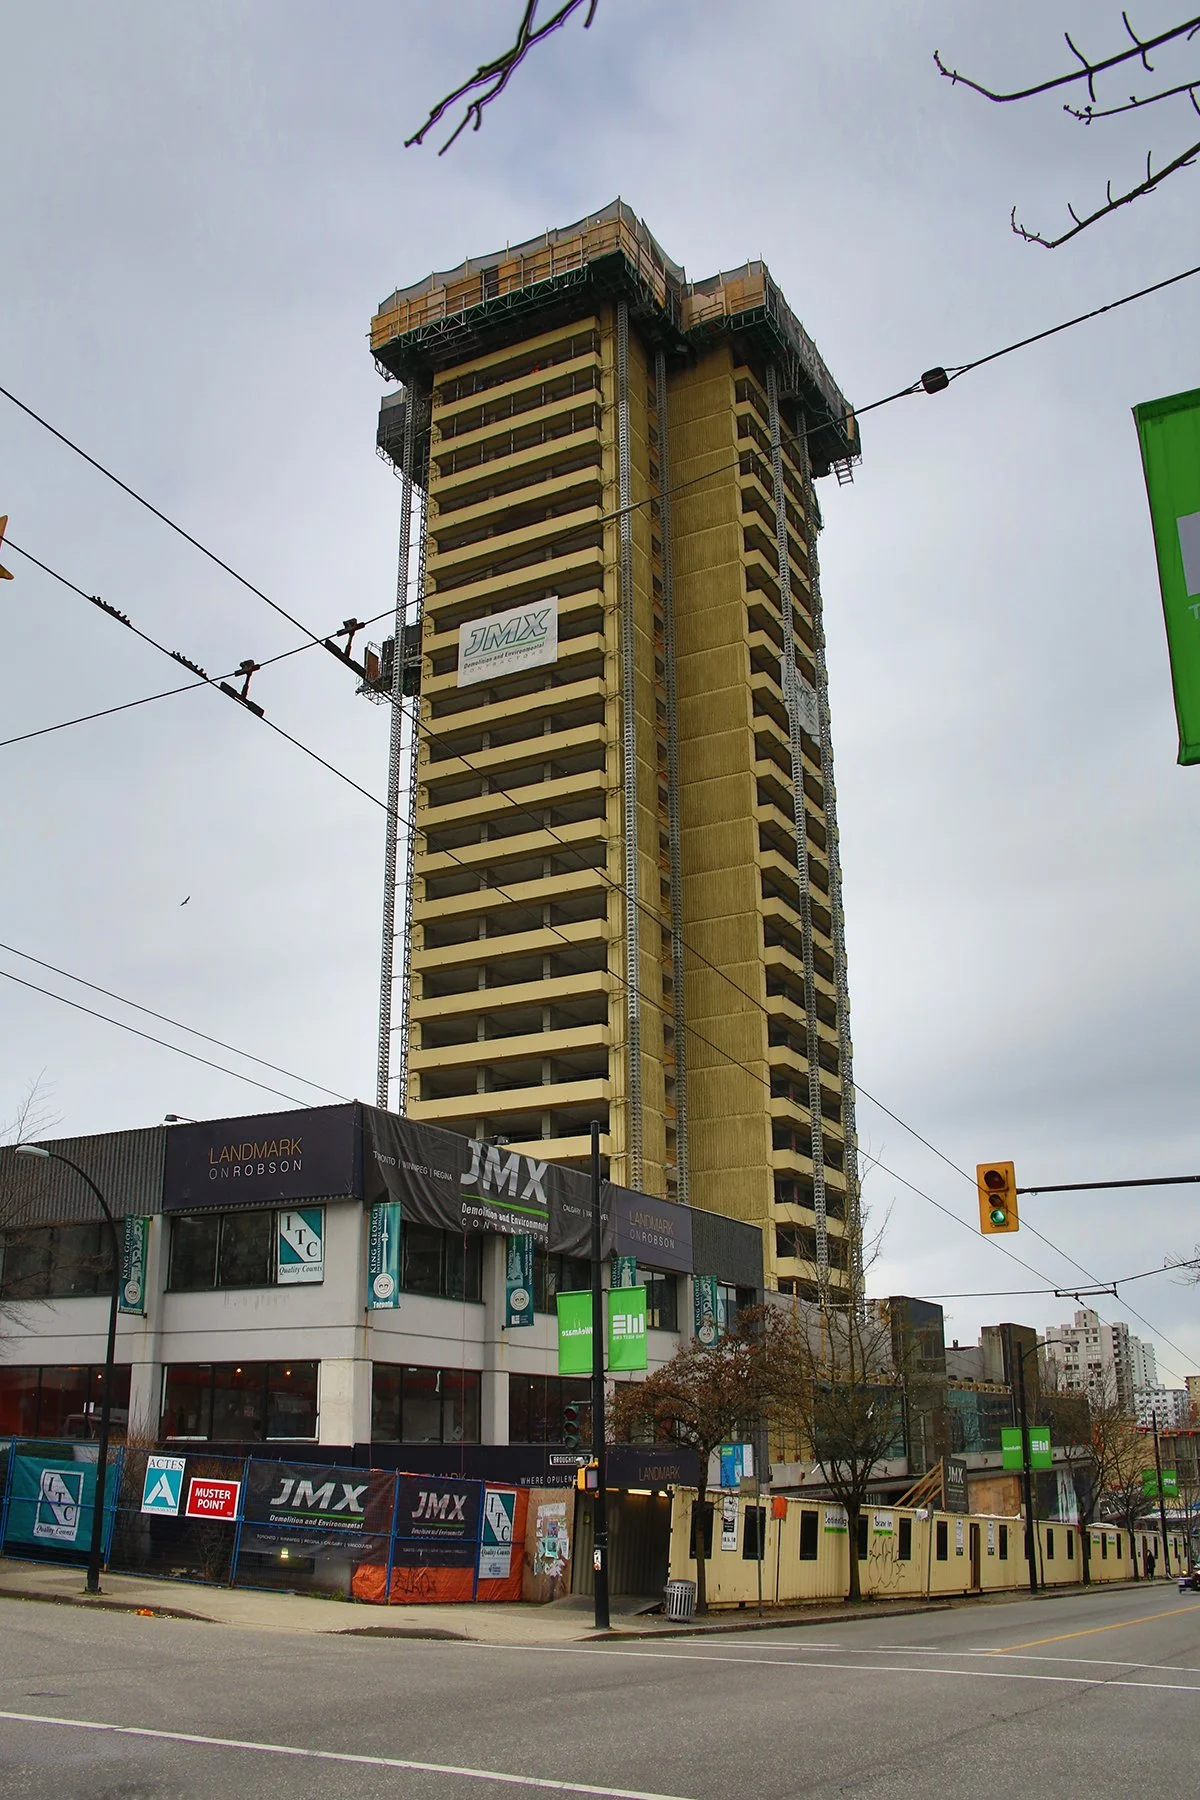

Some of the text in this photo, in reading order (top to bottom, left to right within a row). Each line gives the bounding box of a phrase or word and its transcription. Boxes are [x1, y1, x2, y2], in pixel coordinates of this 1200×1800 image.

[464, 608, 551, 657] JMX
[463, 642, 545, 670] Demolition and Environmental
[209, 1137, 302, 1164] LANDMARK
[460, 1140, 549, 1205] JMX
[461, 1202, 549, 1233] Demolition and Environmental
[629, 1209, 675, 1236] LANDMARK
[279, 1264, 323, 1276] Quality Counts
[373, 1301, 394, 1309] Toronto
[148, 1458, 184, 1470] ACTES
[520, 1476, 544, 1485] WHERE
[639, 1465, 681, 1481] LANDMARK
[947, 1466, 964, 1484] JMX
[195, 1487, 231, 1500] MUSTER
[270, 1478, 369, 1513] JMX
[197, 1499, 226, 1510] POINT
[411, 1491, 467, 1521] JMX
[36, 1525, 54, 1535] Quality
[269, 1514, 364, 1530] Demolition and Environmental
